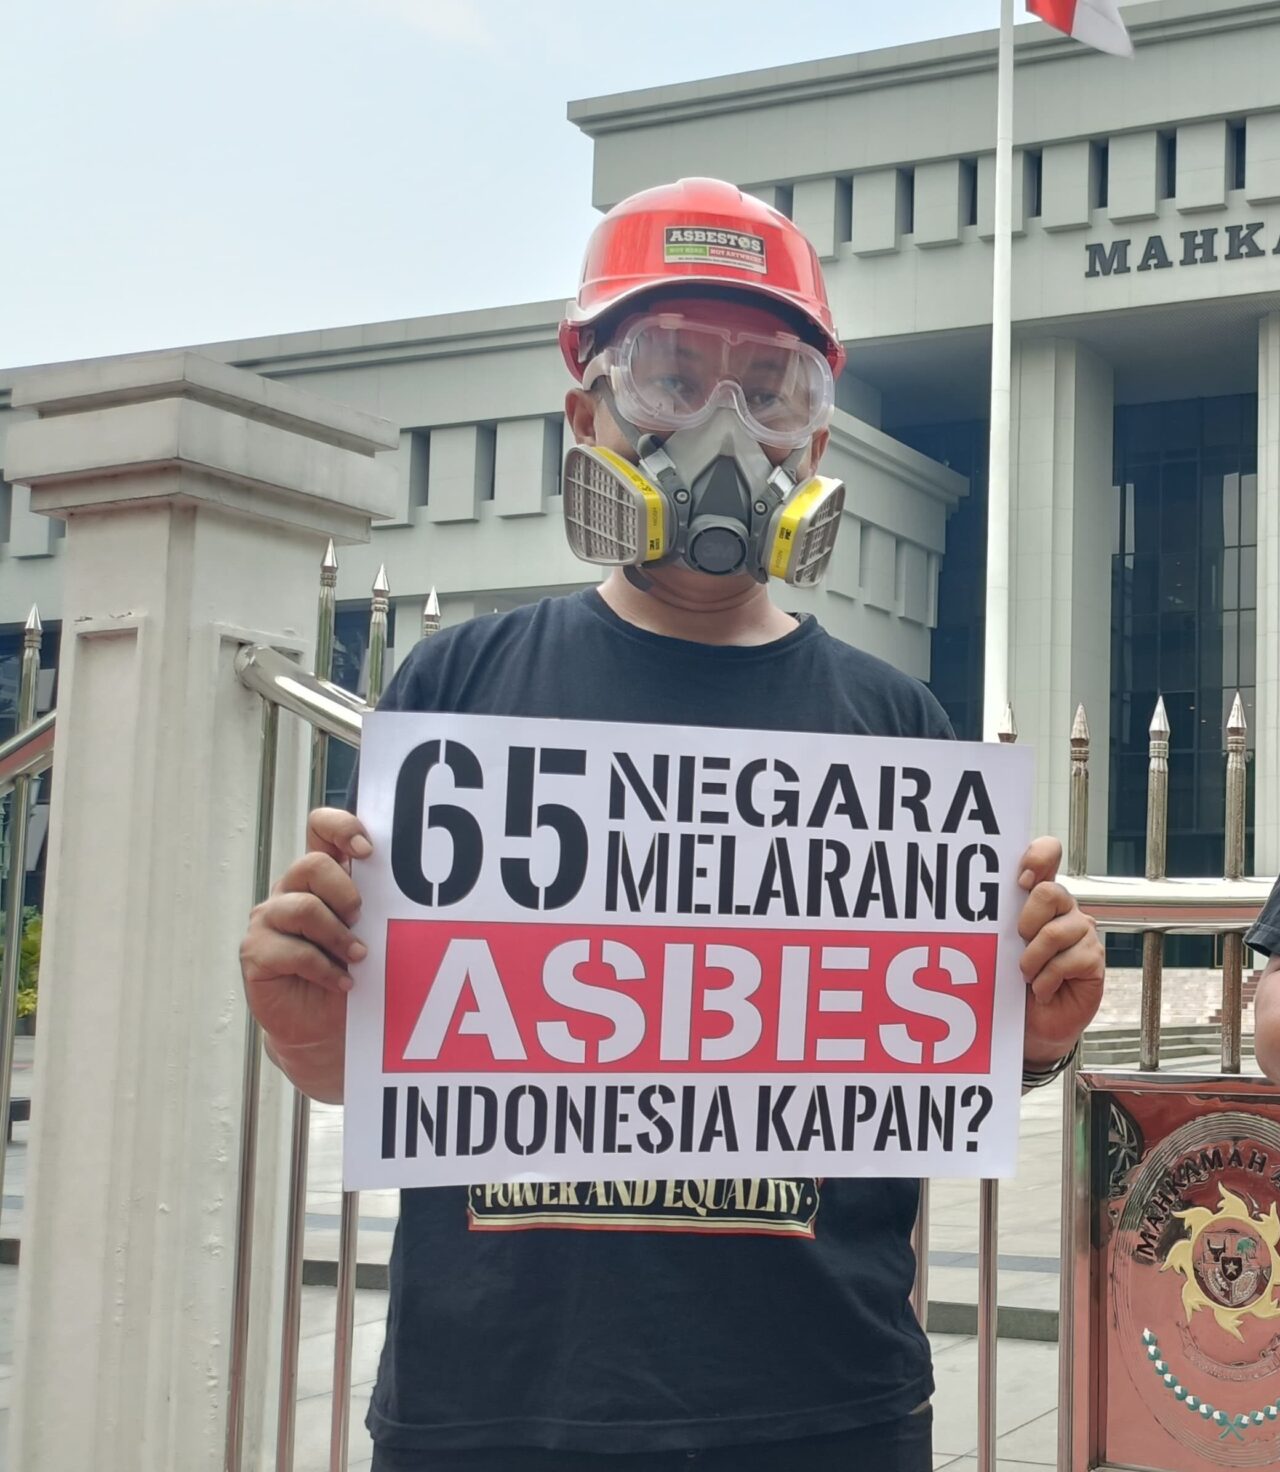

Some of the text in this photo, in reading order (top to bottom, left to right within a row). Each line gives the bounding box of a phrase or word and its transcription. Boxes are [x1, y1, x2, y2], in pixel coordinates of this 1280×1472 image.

[669, 230, 761, 252] ASBESTOS
[391, 739, 588, 910] 65
[608, 752, 1000, 835] NEGARA
[604, 830, 1000, 922] MELARANG
[402, 938, 979, 1065] ASBES
[381, 1083, 994, 1159] INDONESIA KAPAN?
[483, 1178, 807, 1217] POWER AND EQUALITY
[1136, 1147, 1267, 1259] MAHKAMAH
